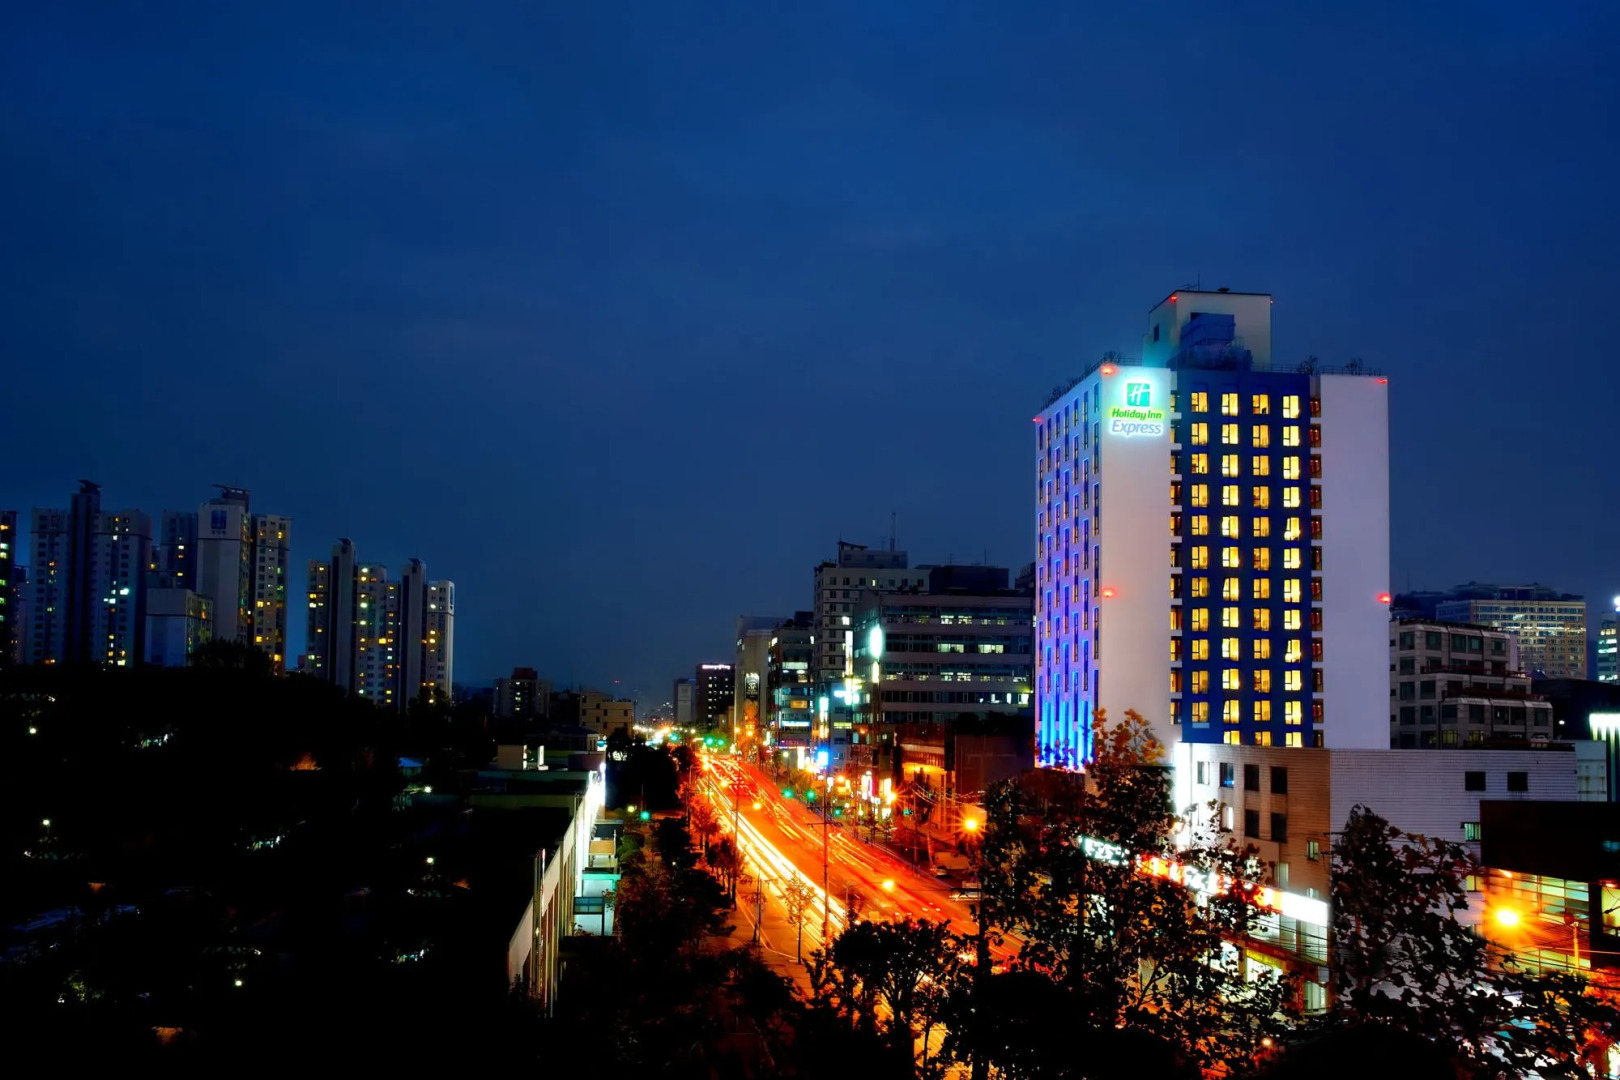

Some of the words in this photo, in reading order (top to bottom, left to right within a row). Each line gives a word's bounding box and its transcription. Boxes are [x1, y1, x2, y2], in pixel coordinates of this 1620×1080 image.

[1112, 408, 1146, 420] Holiday
[1148, 410, 1162, 419] Inn
[1112, 420, 1161, 435] Express
